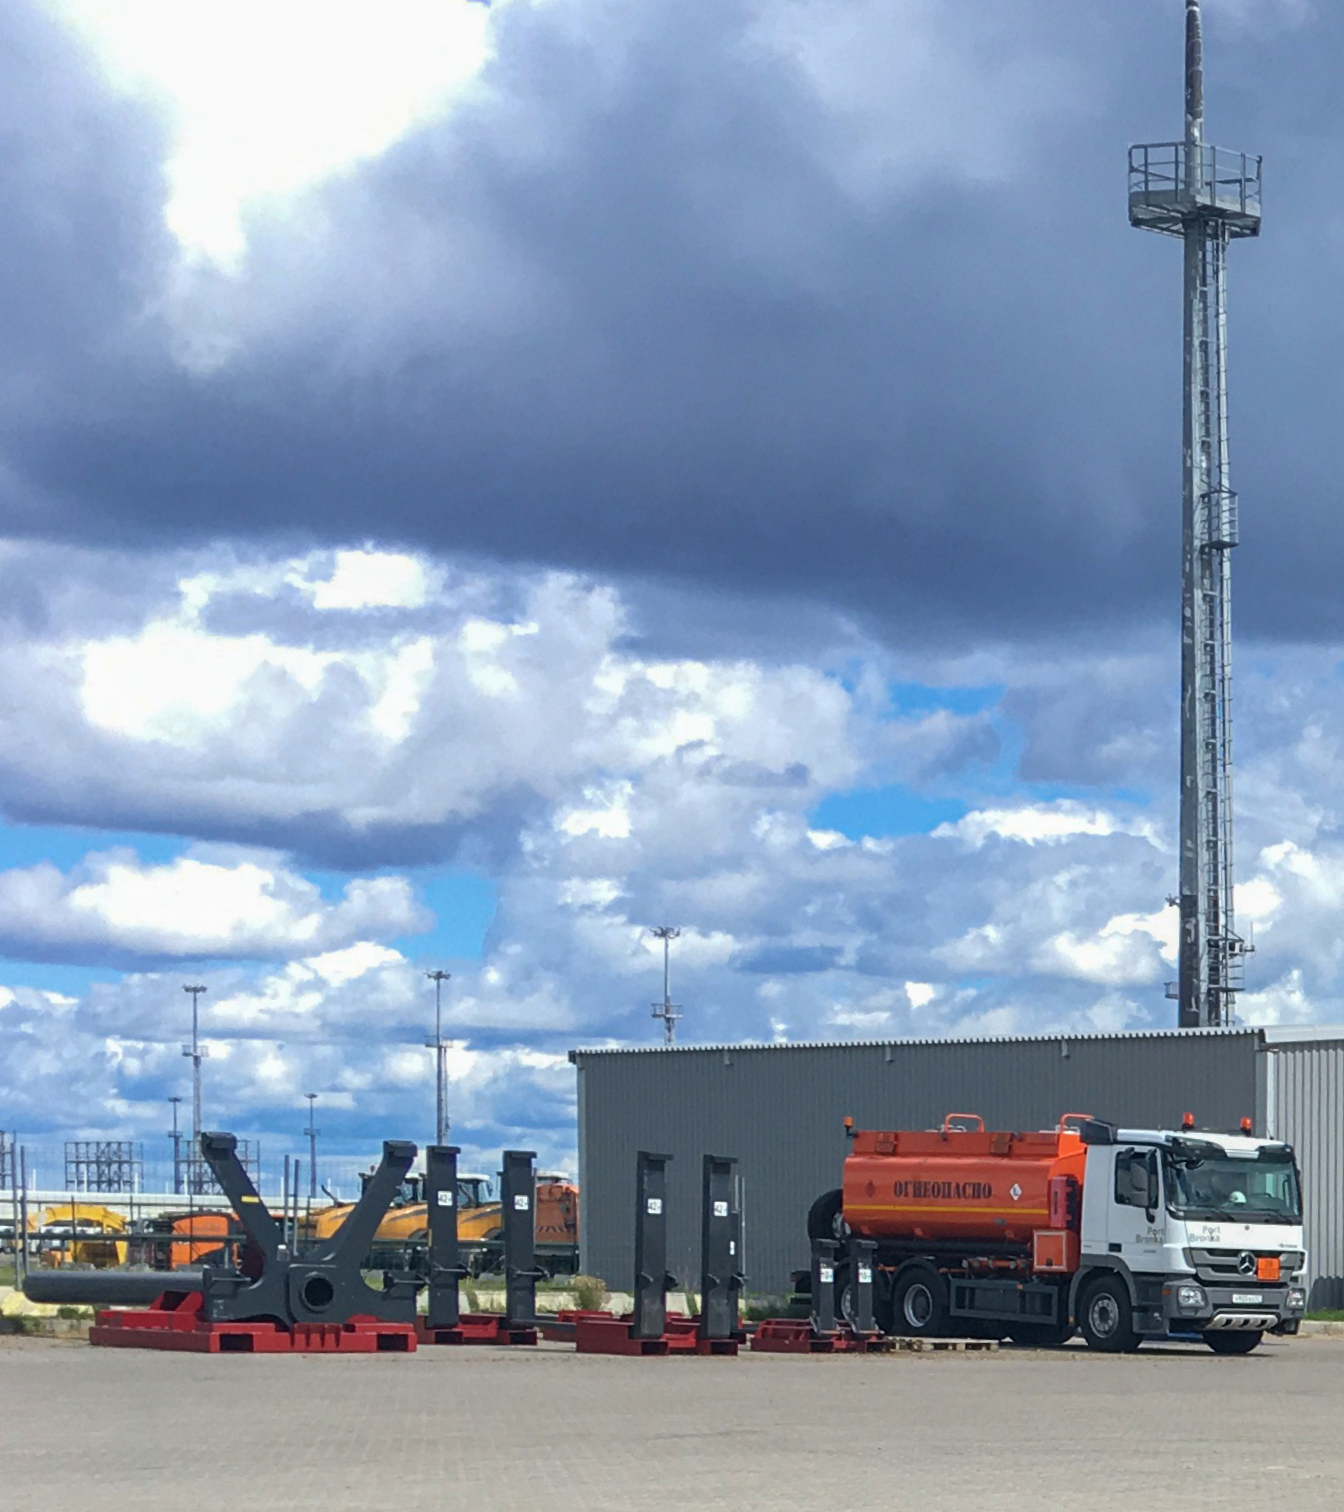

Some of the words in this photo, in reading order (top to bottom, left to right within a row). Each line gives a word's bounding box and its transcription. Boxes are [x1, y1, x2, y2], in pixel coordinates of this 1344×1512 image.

[893, 1180, 993, 1200] ОГНЕОПАСНО
[1203, 1225, 1220, 1234] Port
[1190, 1233, 1220, 1242] Bronka
